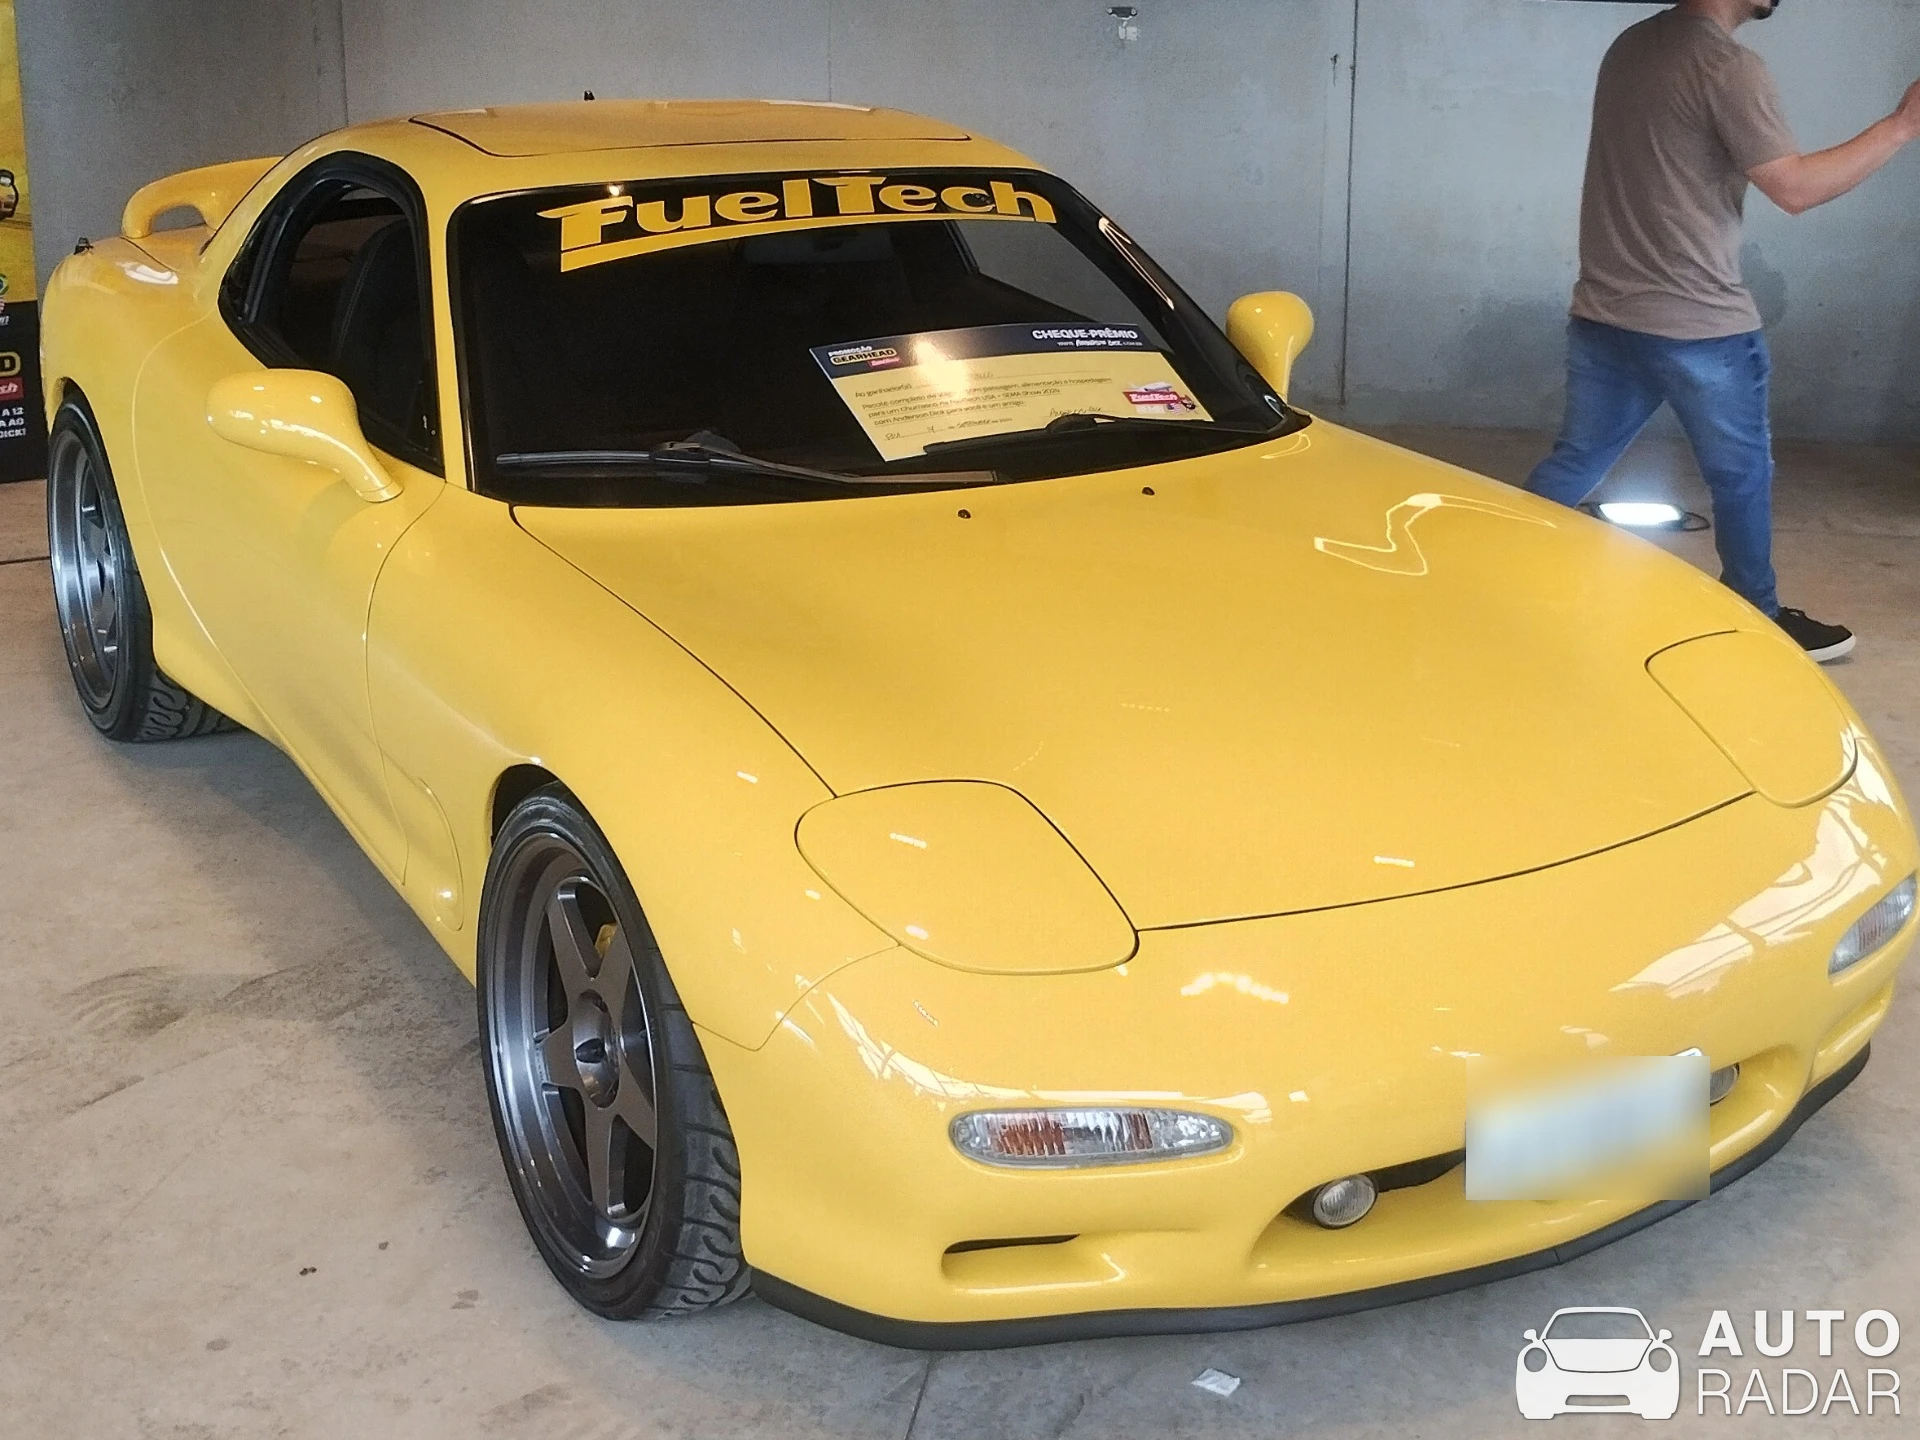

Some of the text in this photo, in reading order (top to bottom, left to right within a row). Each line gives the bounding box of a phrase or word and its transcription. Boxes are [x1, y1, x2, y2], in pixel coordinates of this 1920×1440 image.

[536, 176, 1057, 254] FuelTech
[1032, 327, 1138, 340] CHEQUE-PRÊMIO
[832, 349, 895, 364] GEARHEAD
